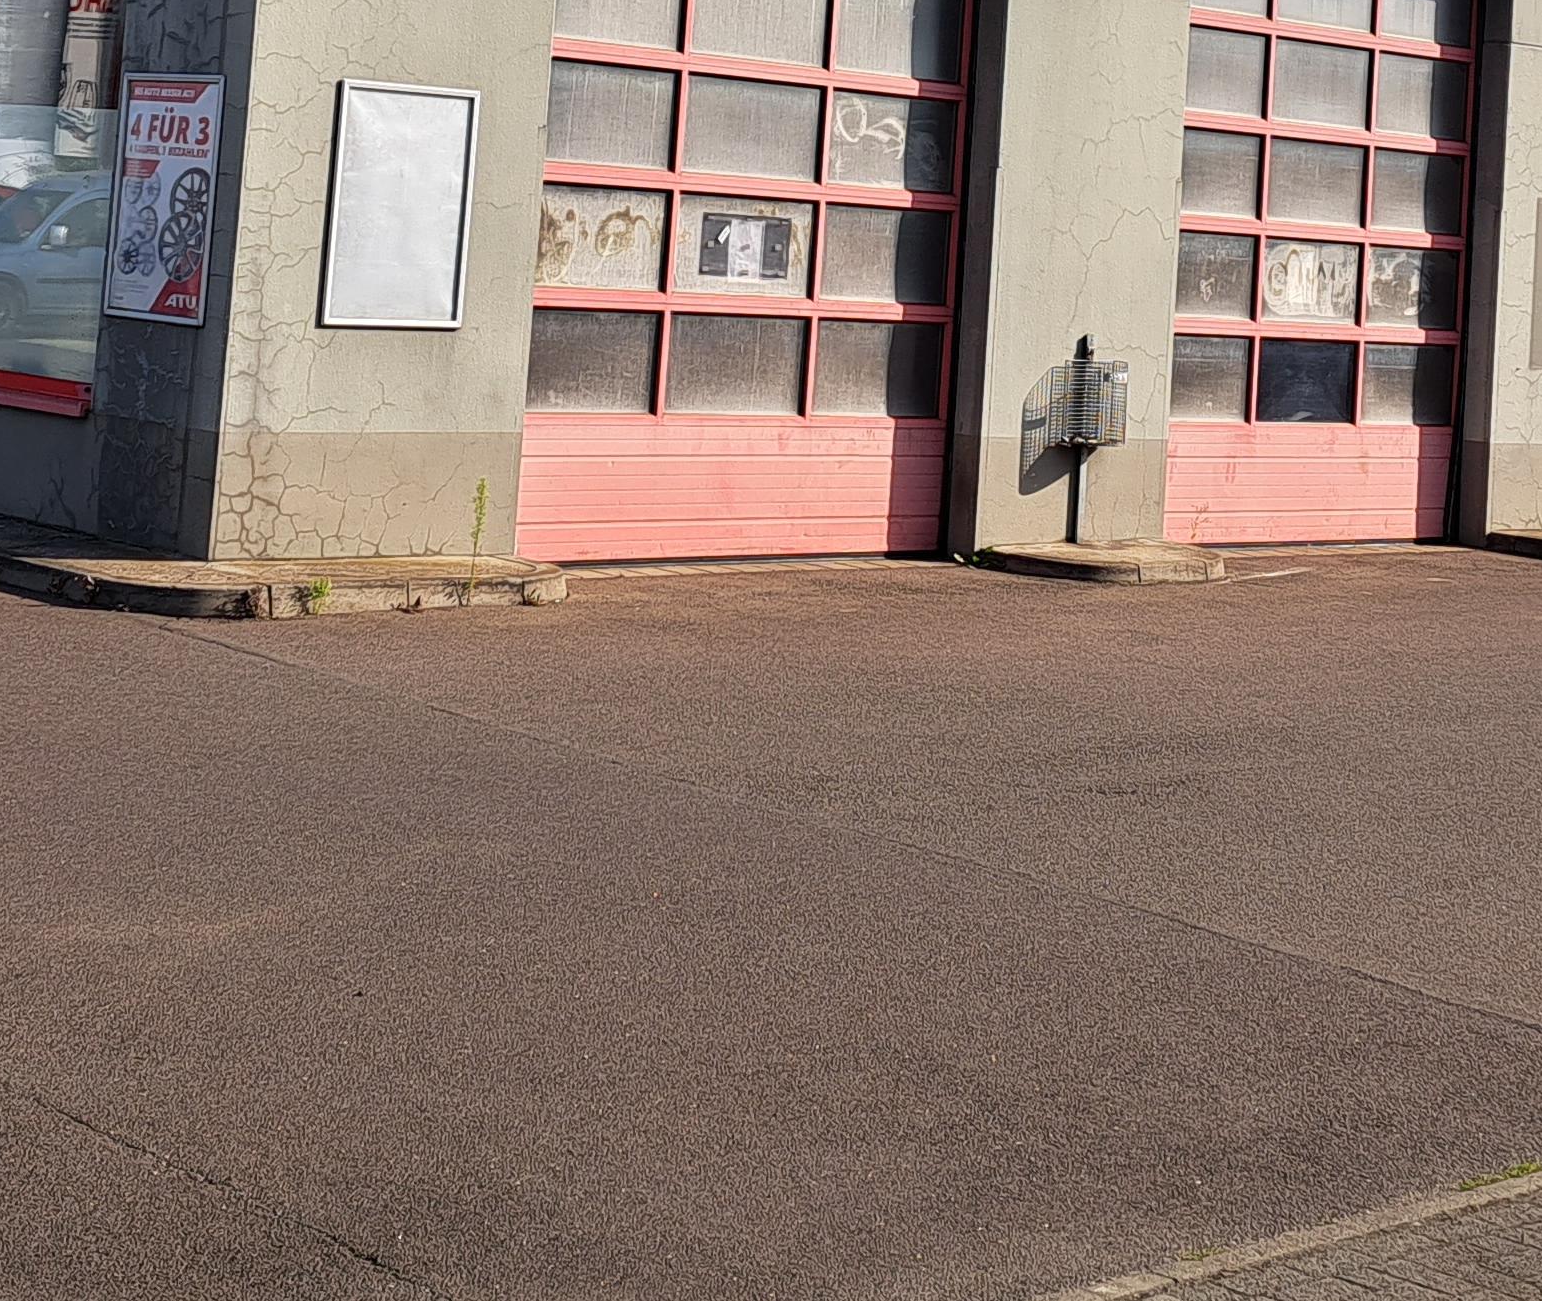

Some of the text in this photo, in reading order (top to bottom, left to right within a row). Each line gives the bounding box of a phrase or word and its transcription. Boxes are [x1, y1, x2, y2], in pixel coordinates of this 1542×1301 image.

[131, 106, 210, 146] 4 FÜR 3
[165, 293, 197, 310] ATU
